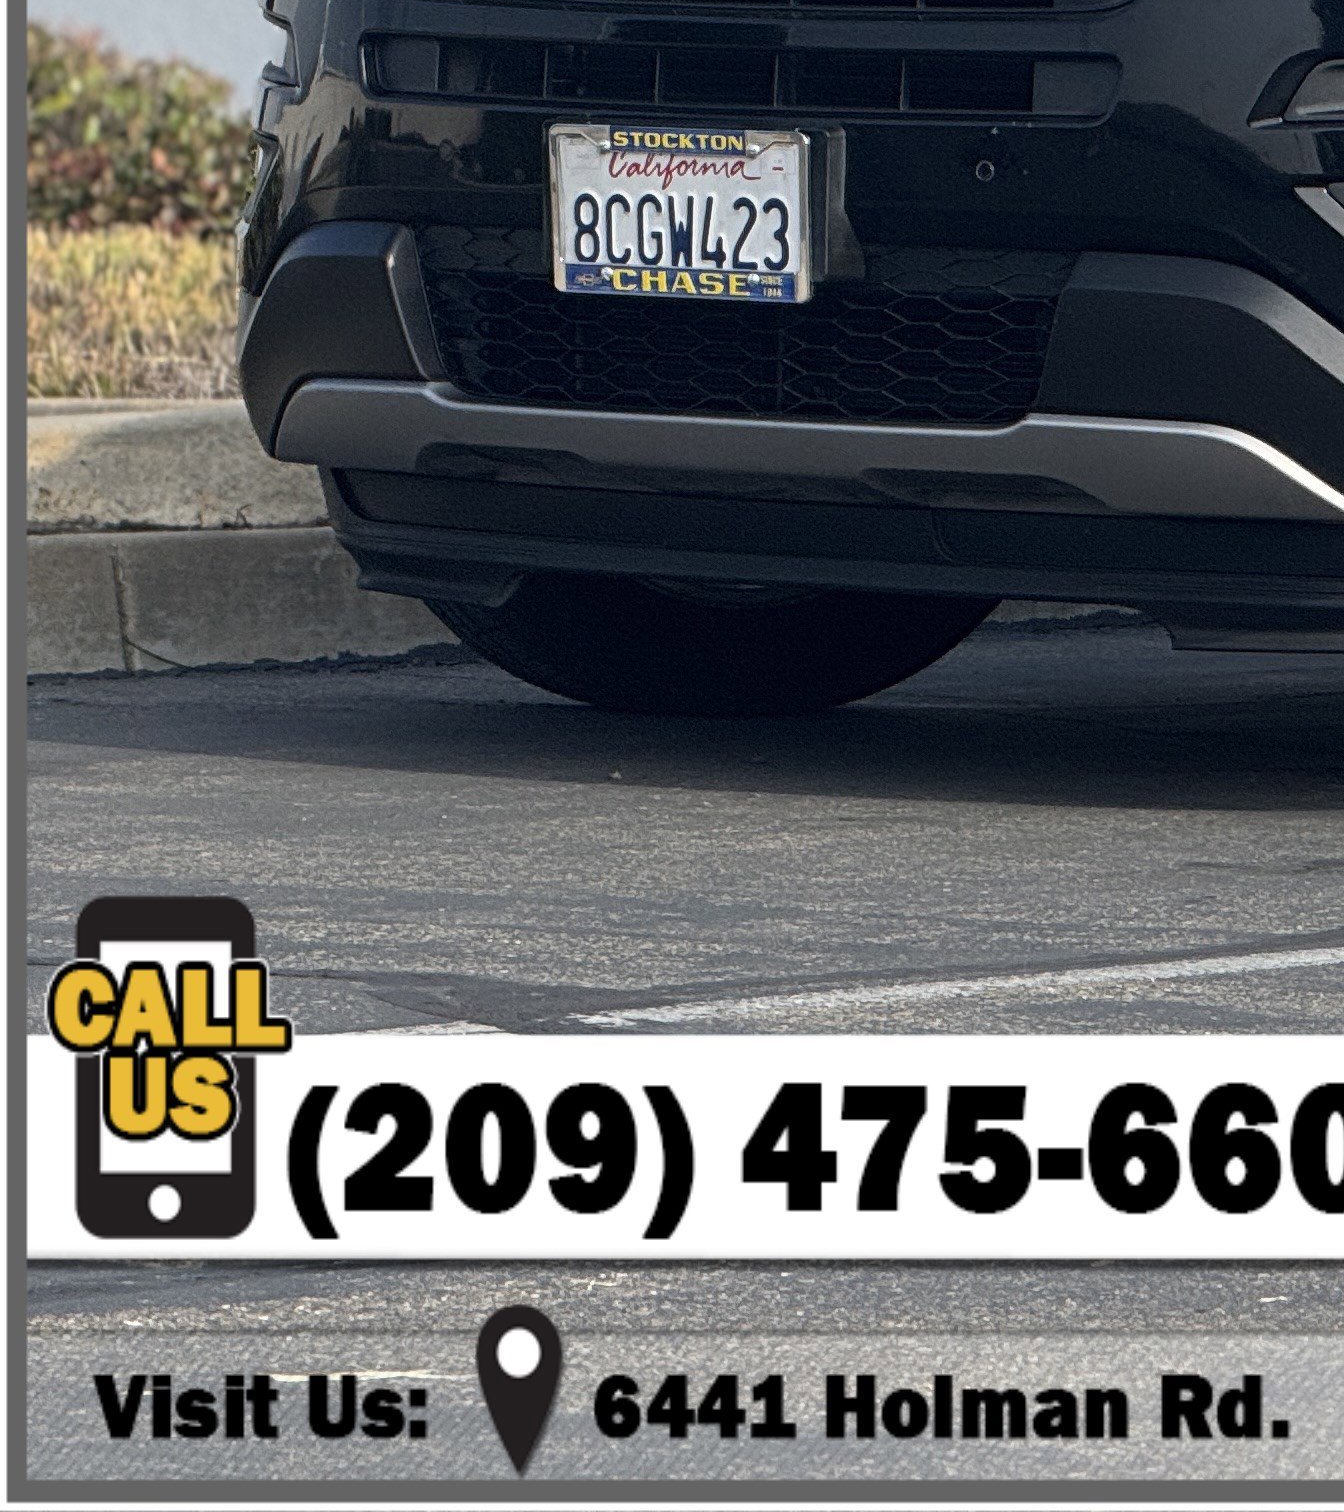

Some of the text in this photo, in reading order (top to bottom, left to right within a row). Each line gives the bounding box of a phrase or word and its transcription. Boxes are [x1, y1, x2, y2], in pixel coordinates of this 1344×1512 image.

[613, 131, 743, 151] STOCKTON
[608, 151, 761, 190] California
[574, 193, 789, 271] 8CGW423
[612, 268, 750, 297] CHASE
